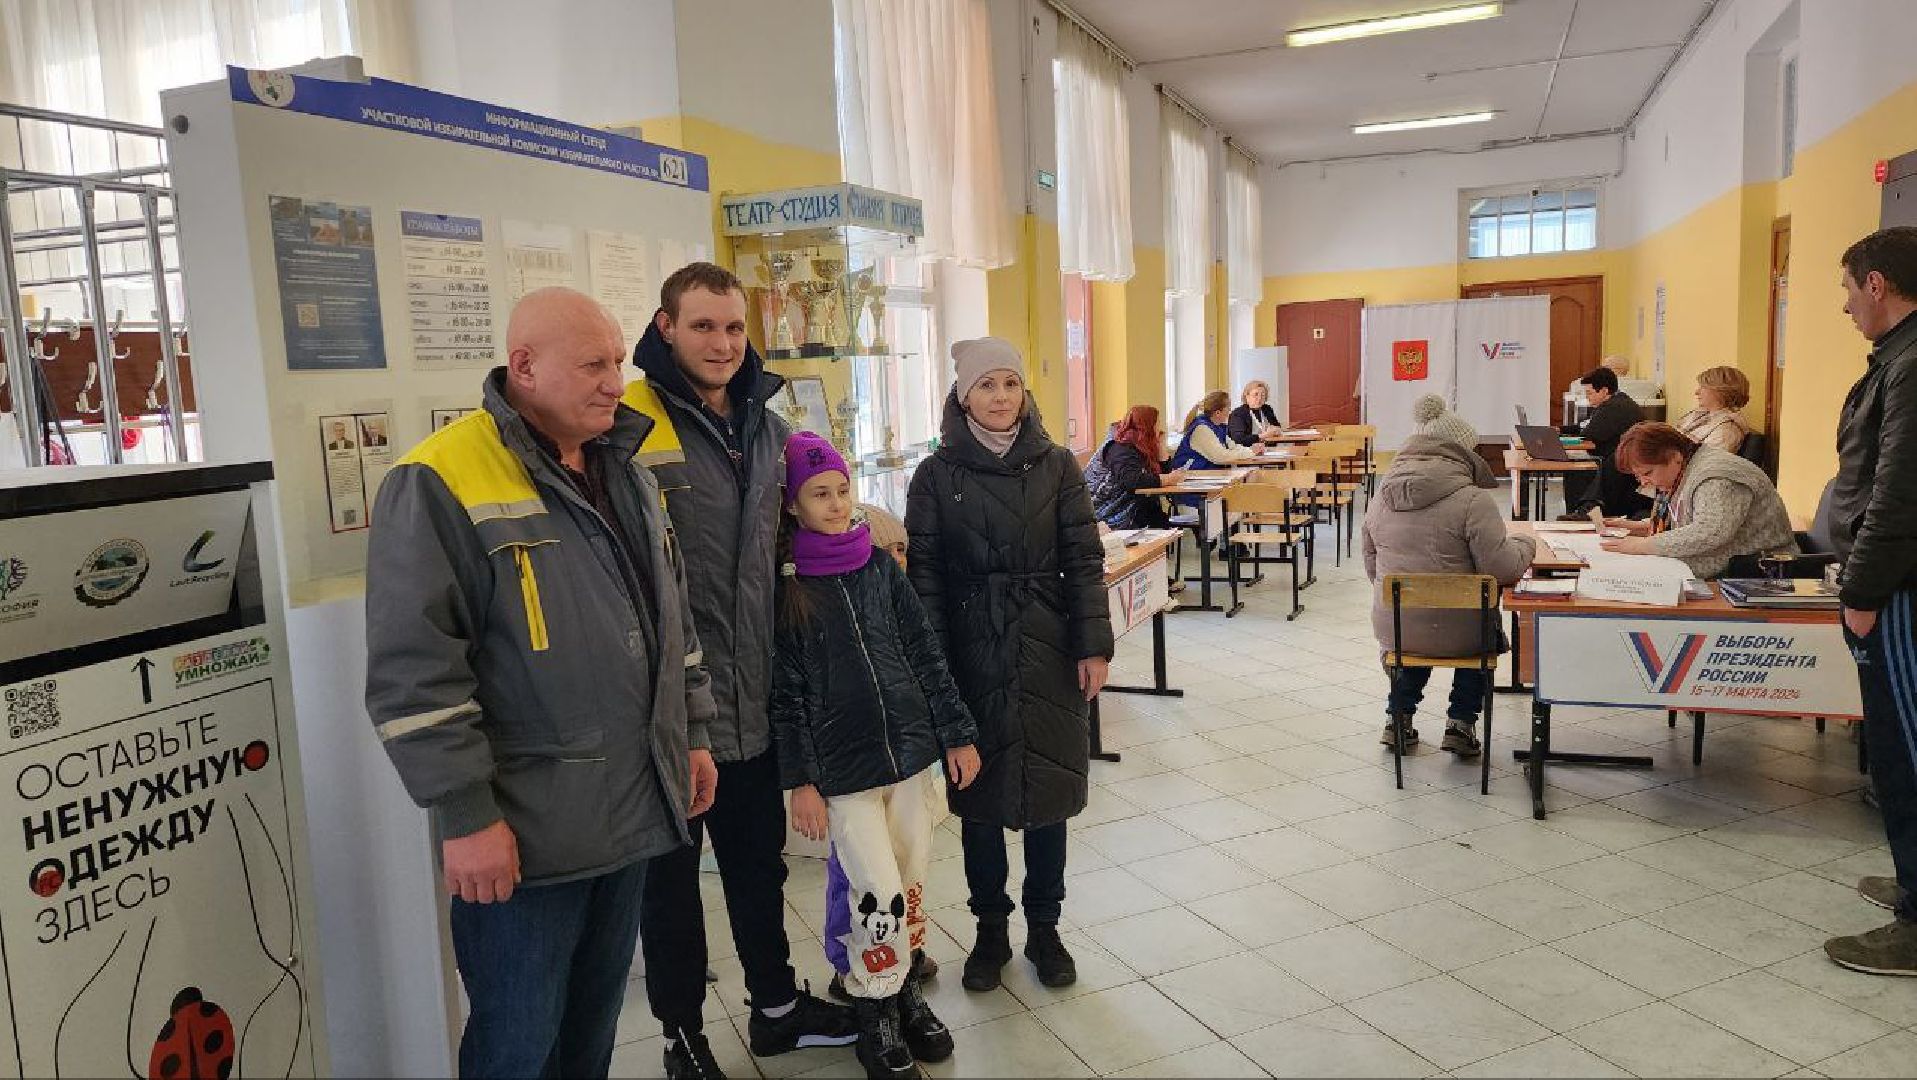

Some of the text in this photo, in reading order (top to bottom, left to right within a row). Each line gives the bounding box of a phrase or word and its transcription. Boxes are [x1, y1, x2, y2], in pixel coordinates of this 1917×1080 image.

[360, 106, 432, 131] УЧАСТКОВОЙ
[433, 121, 511, 147] ИЗБИРАТЕЛЬНОЙ
[512, 138, 558, 157] КОМИССИИ
[662, 156, 686, 181] 621
[485, 111, 607, 151] ИНФОРМАЦИОННЫЙ СТЕНД
[722, 193, 841, 227] ТЕАТР-СТУДИЯ
[0, 599, 39, 613] ОФИЯ
[1715, 634, 1795, 649] ВЫБОРЫ
[1697, 668, 1769, 684] РОССИИ
[1706, 652, 1817, 669] ПРЕЗИДЕНТА
[1725, 686, 1768, 698] МАРТА
[1769, 687, 1800, 700] 2024
[16, 712, 219, 801] ОСТАВЬТЕ
[22, 739, 270, 853] НЕНУЖНУЮ
[28, 798, 216, 898] ОДЕЖДУ
[35, 866, 171, 944] ЗДЕСЬ
